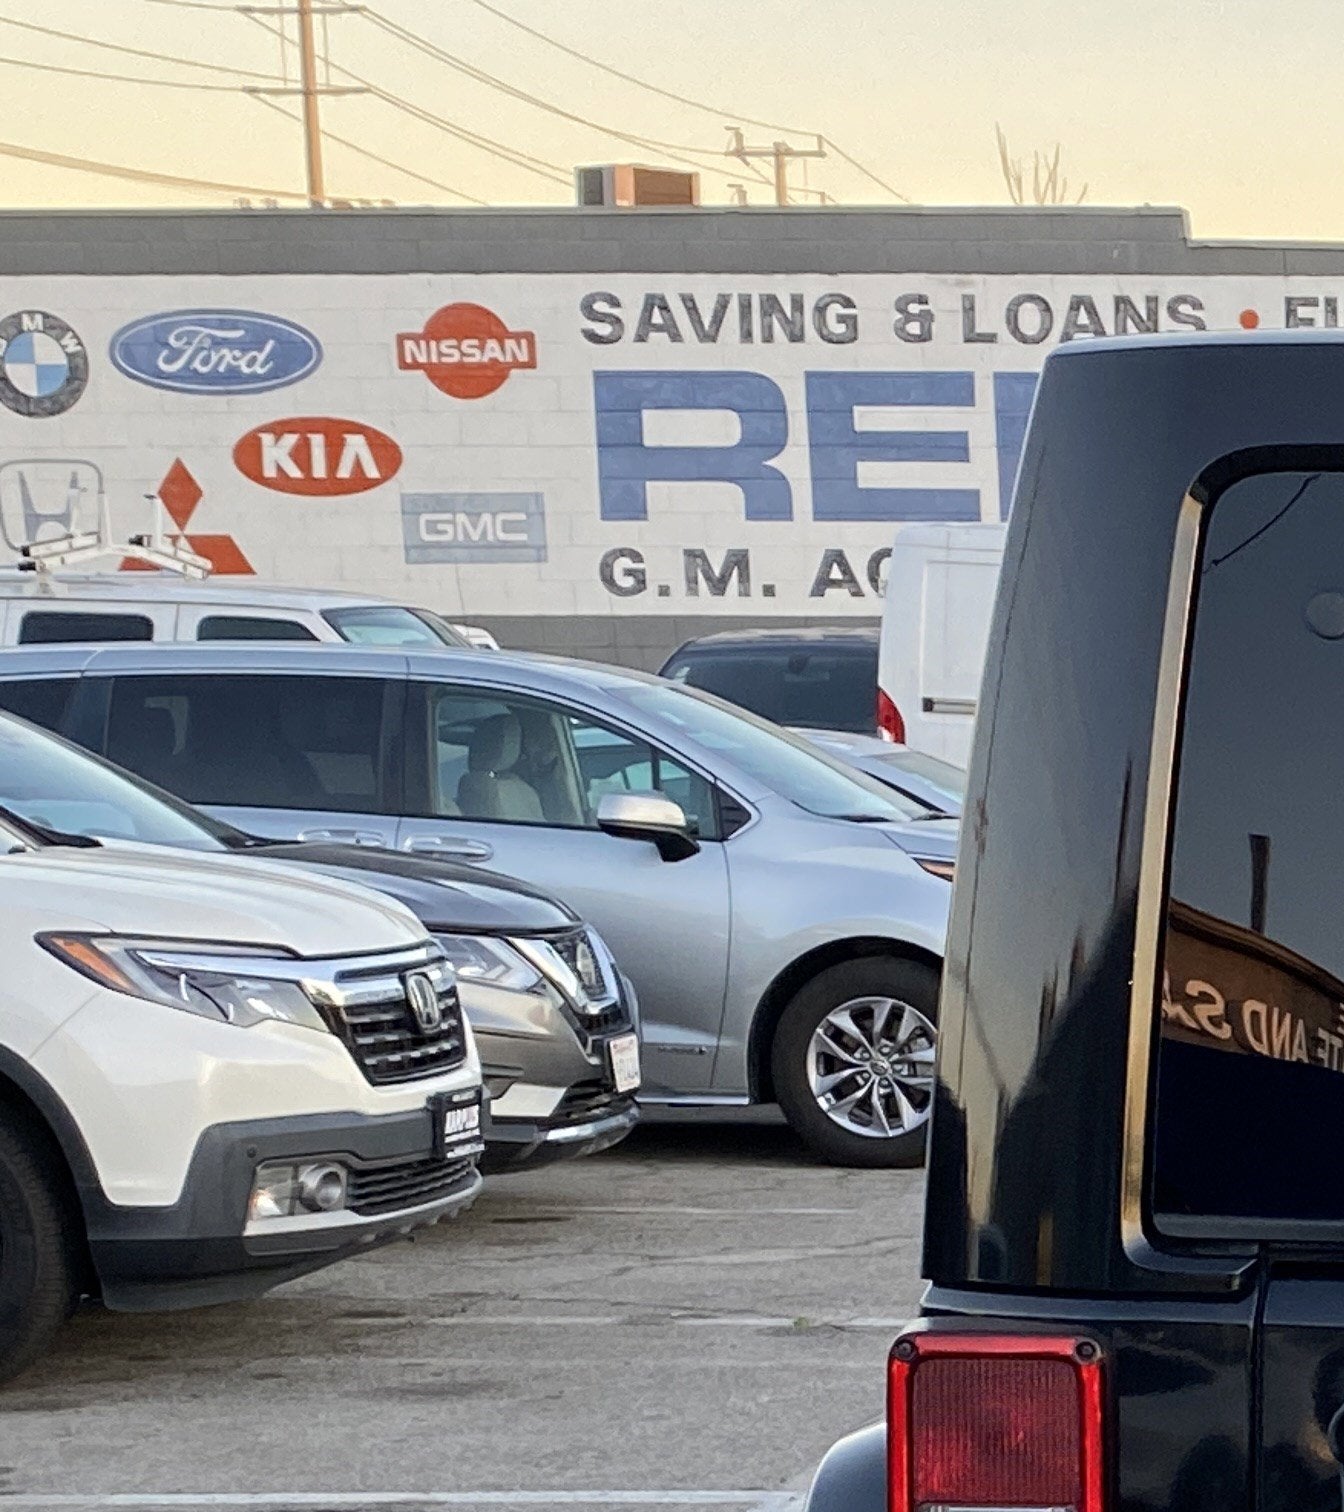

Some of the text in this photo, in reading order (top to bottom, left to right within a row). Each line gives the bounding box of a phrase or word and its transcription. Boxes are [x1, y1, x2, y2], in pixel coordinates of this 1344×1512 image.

[579, 291, 1207, 346] SAVING & LOANS
[157, 325, 275, 377] Ford
[402, 338, 531, 366] NISSAN
[257, 431, 381, 480] KIA
[418, 509, 529, 543] GMC
[599, 547, 777, 599] G.M.
